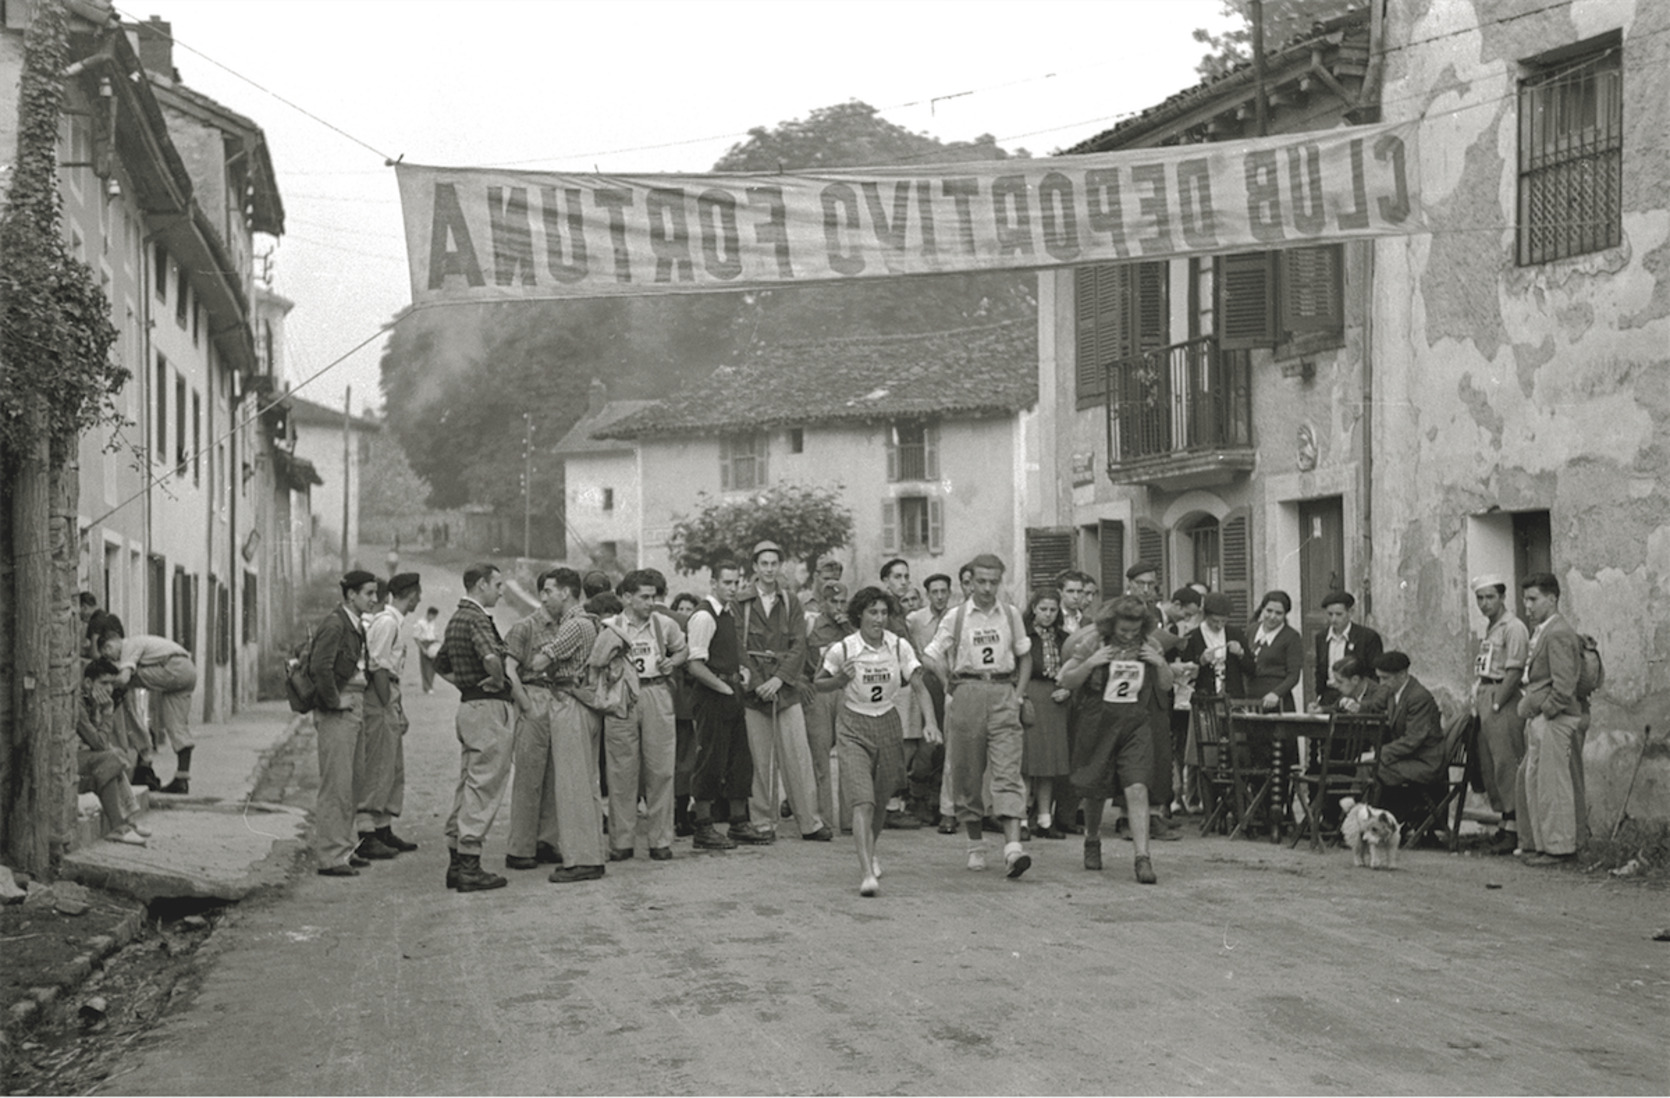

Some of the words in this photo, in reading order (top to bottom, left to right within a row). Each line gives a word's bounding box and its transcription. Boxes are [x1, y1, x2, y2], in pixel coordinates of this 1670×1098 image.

[983, 647, 994, 664] 2
[871, 686, 882, 702] 2
[1118, 682, 1129, 697] 2
